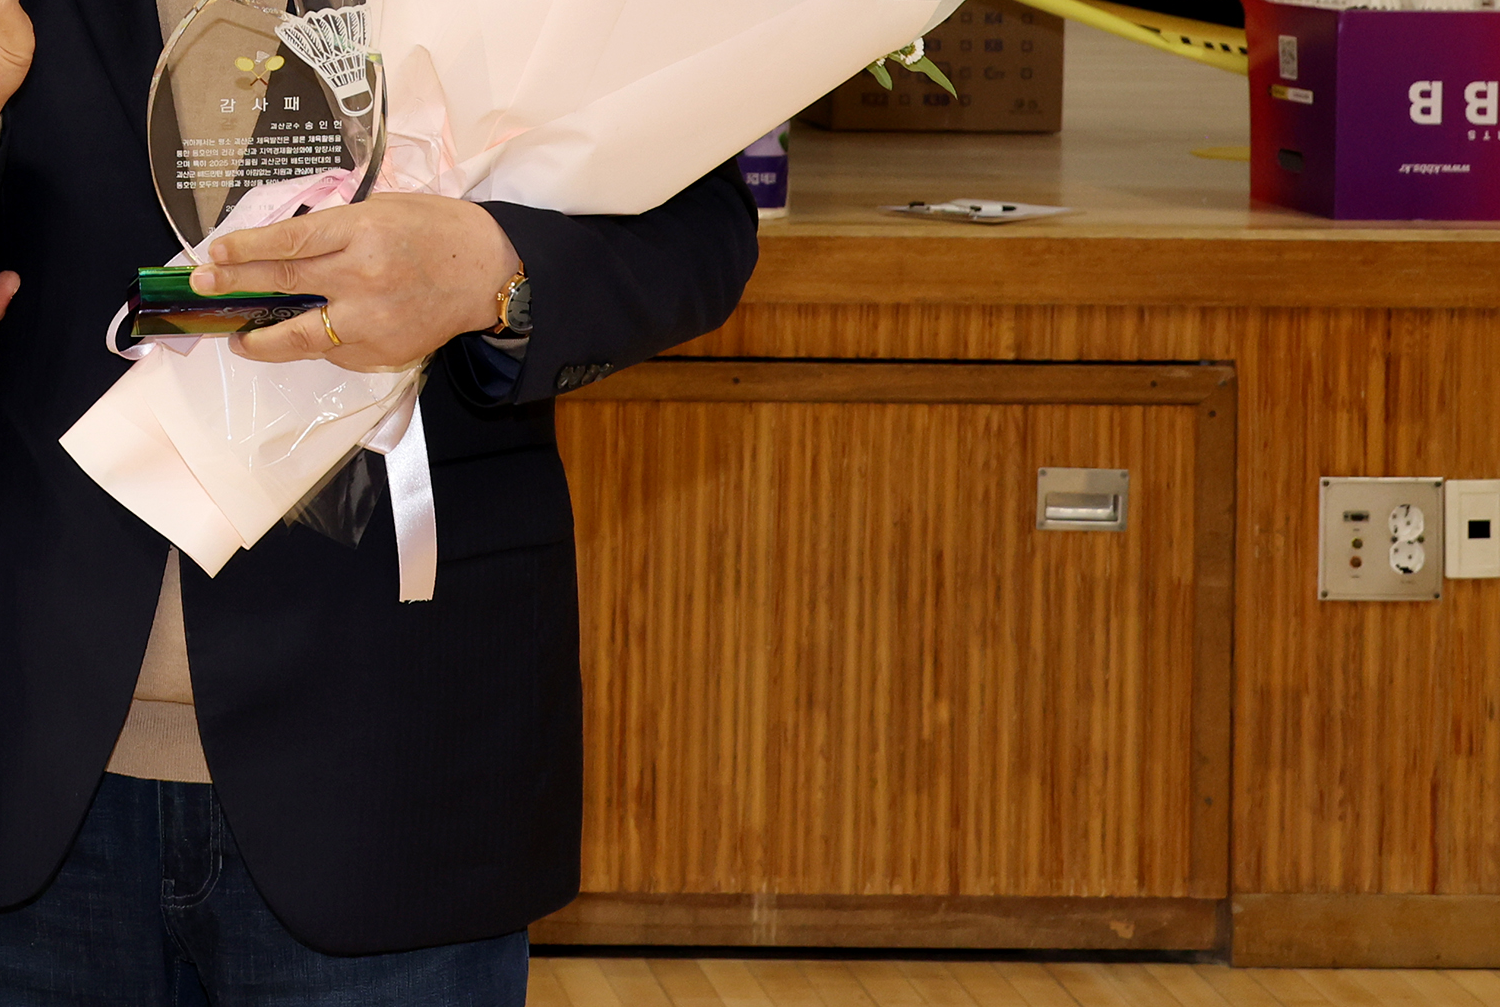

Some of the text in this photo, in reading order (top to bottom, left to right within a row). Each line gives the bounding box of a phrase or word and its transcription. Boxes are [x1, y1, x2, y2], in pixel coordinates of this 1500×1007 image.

[270, 122, 300, 130] 괴산군수
[182, 134, 342, 147] 귀하께서는 평소 괴산군 체육발전은 물론 체육활동을
[192, 148, 219, 157] 동호인의
[221, 148, 235, 156] 건강
[176, 160, 190, 168] 으며
[193, 159, 207, 167] 특히
[209, 159, 229, 167] 2025
[261, 157, 288, 166] 괴산군민
[290, 156, 332, 165] 배드민턴대회
[176, 170, 196, 179] 괴산군
[197, 169, 223, 178] 배드민턴
[176, 181, 197, 190] 동호인
